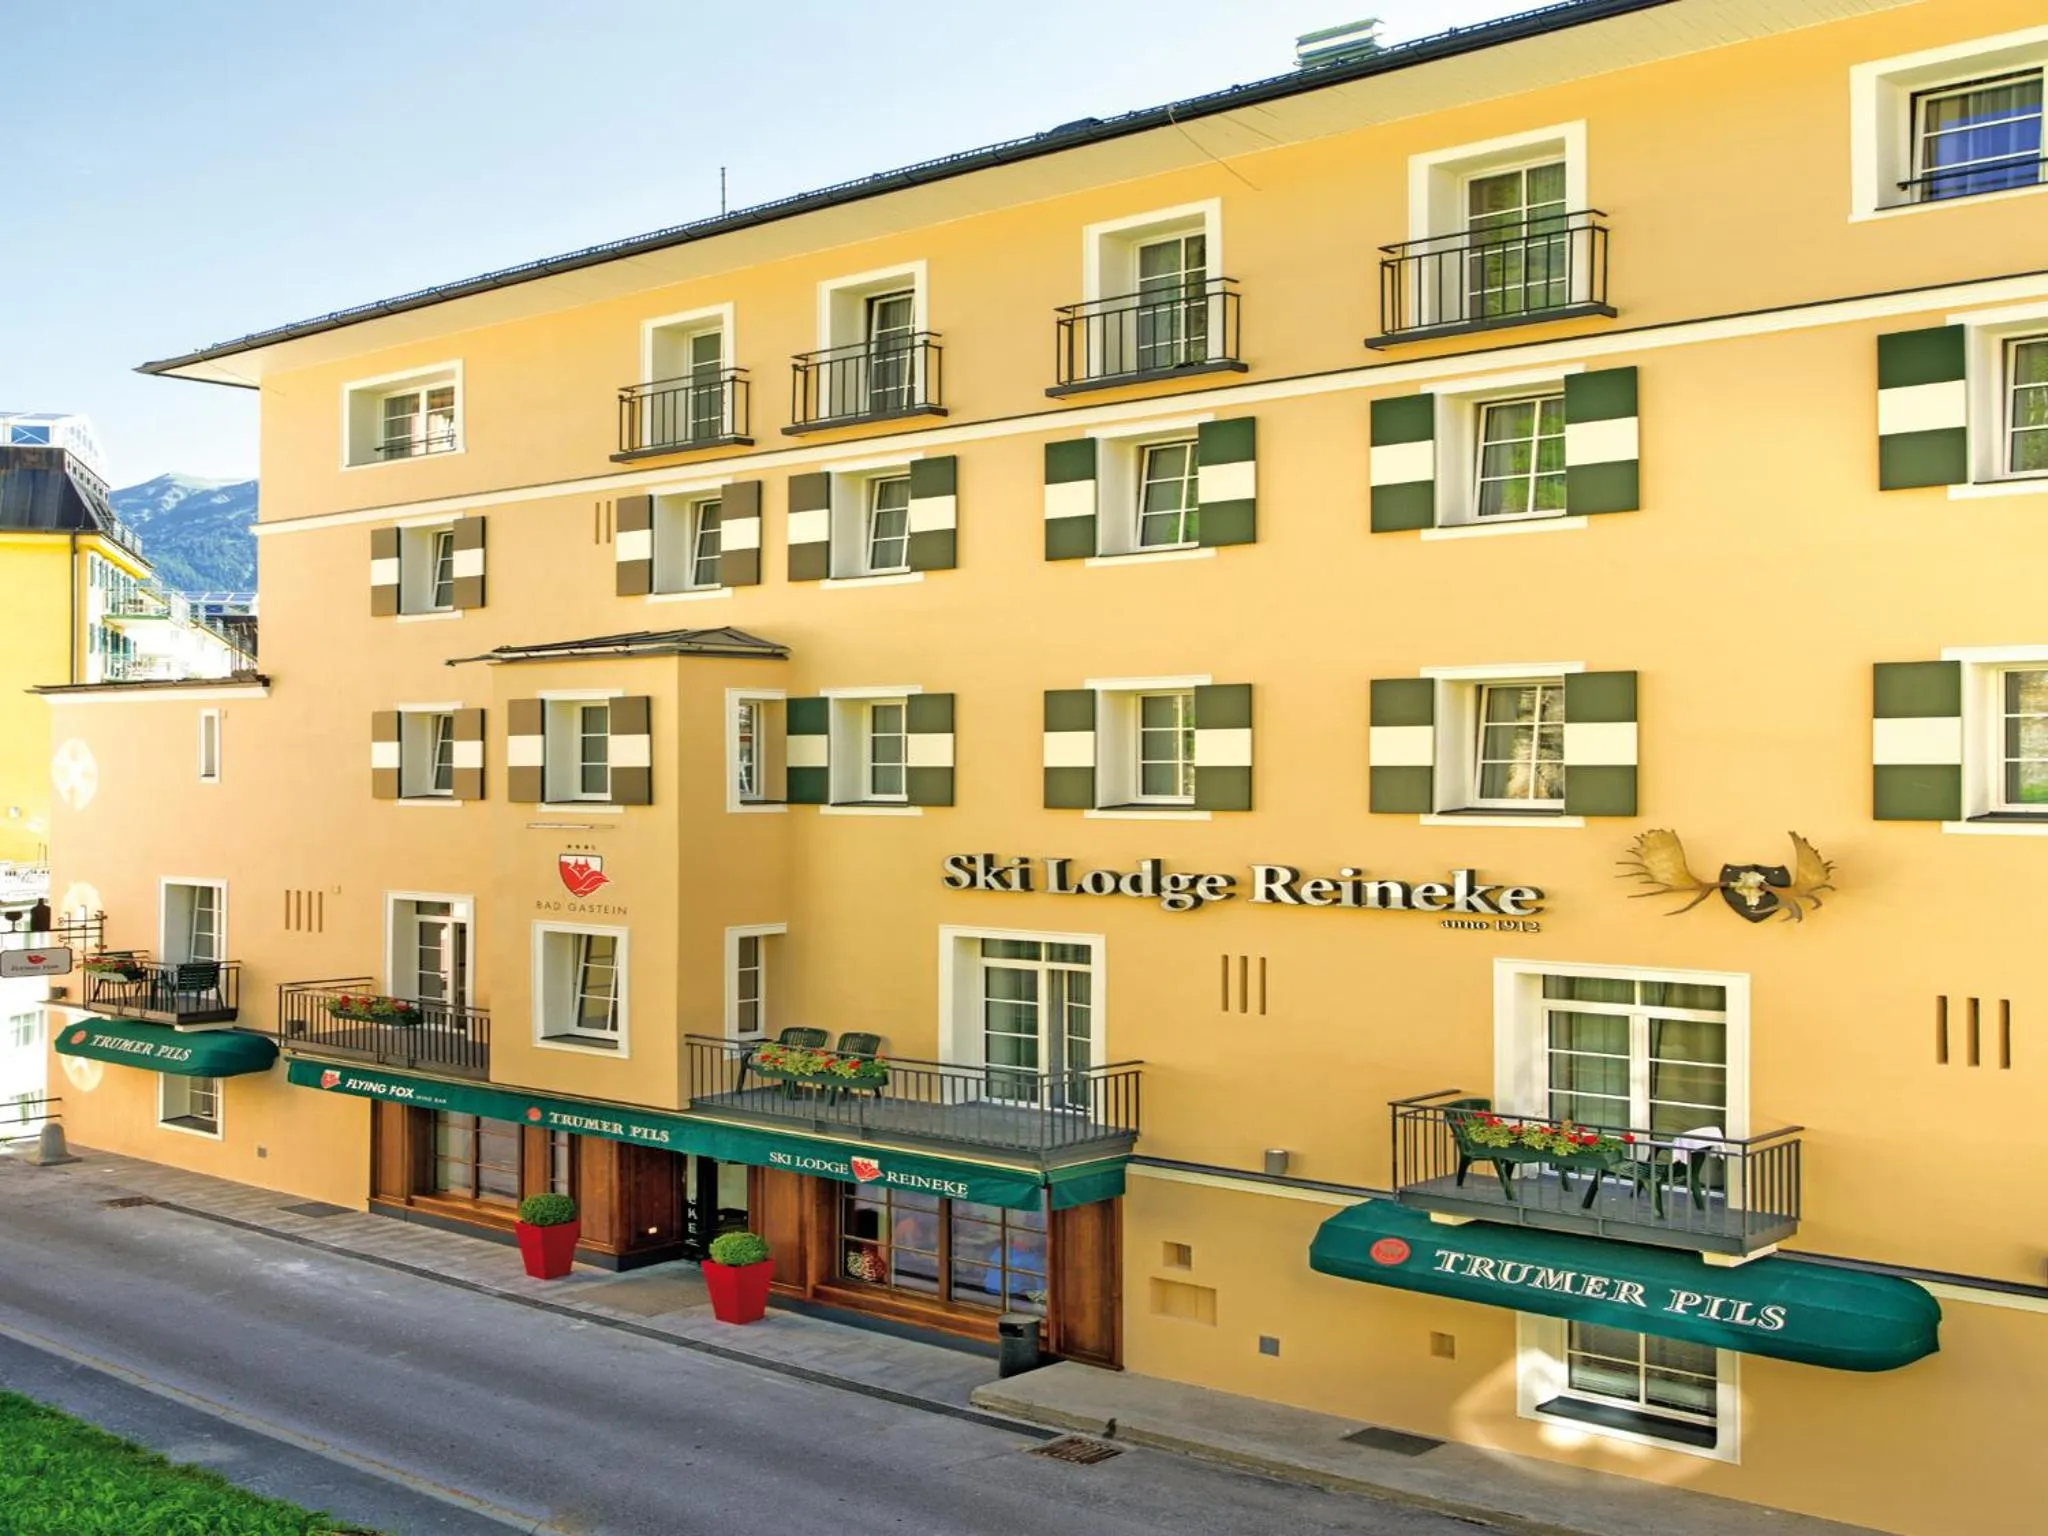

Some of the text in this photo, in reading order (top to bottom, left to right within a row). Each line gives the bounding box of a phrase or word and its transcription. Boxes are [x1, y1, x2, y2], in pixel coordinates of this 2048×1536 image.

[943, 853, 1546, 916] Ski Lodge Reineke
[536, 900, 627, 915] BAD GASTEIN
[1440, 919, 1541, 933] anno 1912
[89, 1034, 192, 1062] TRUMER PILS
[345, 1078, 415, 1099] FLYING FOX
[548, 1112, 670, 1143] TRUMER PILS
[769, 1151, 969, 1195] SKI LODGE REINEKE
[1433, 1250, 1788, 1331] TRUMER PILS
